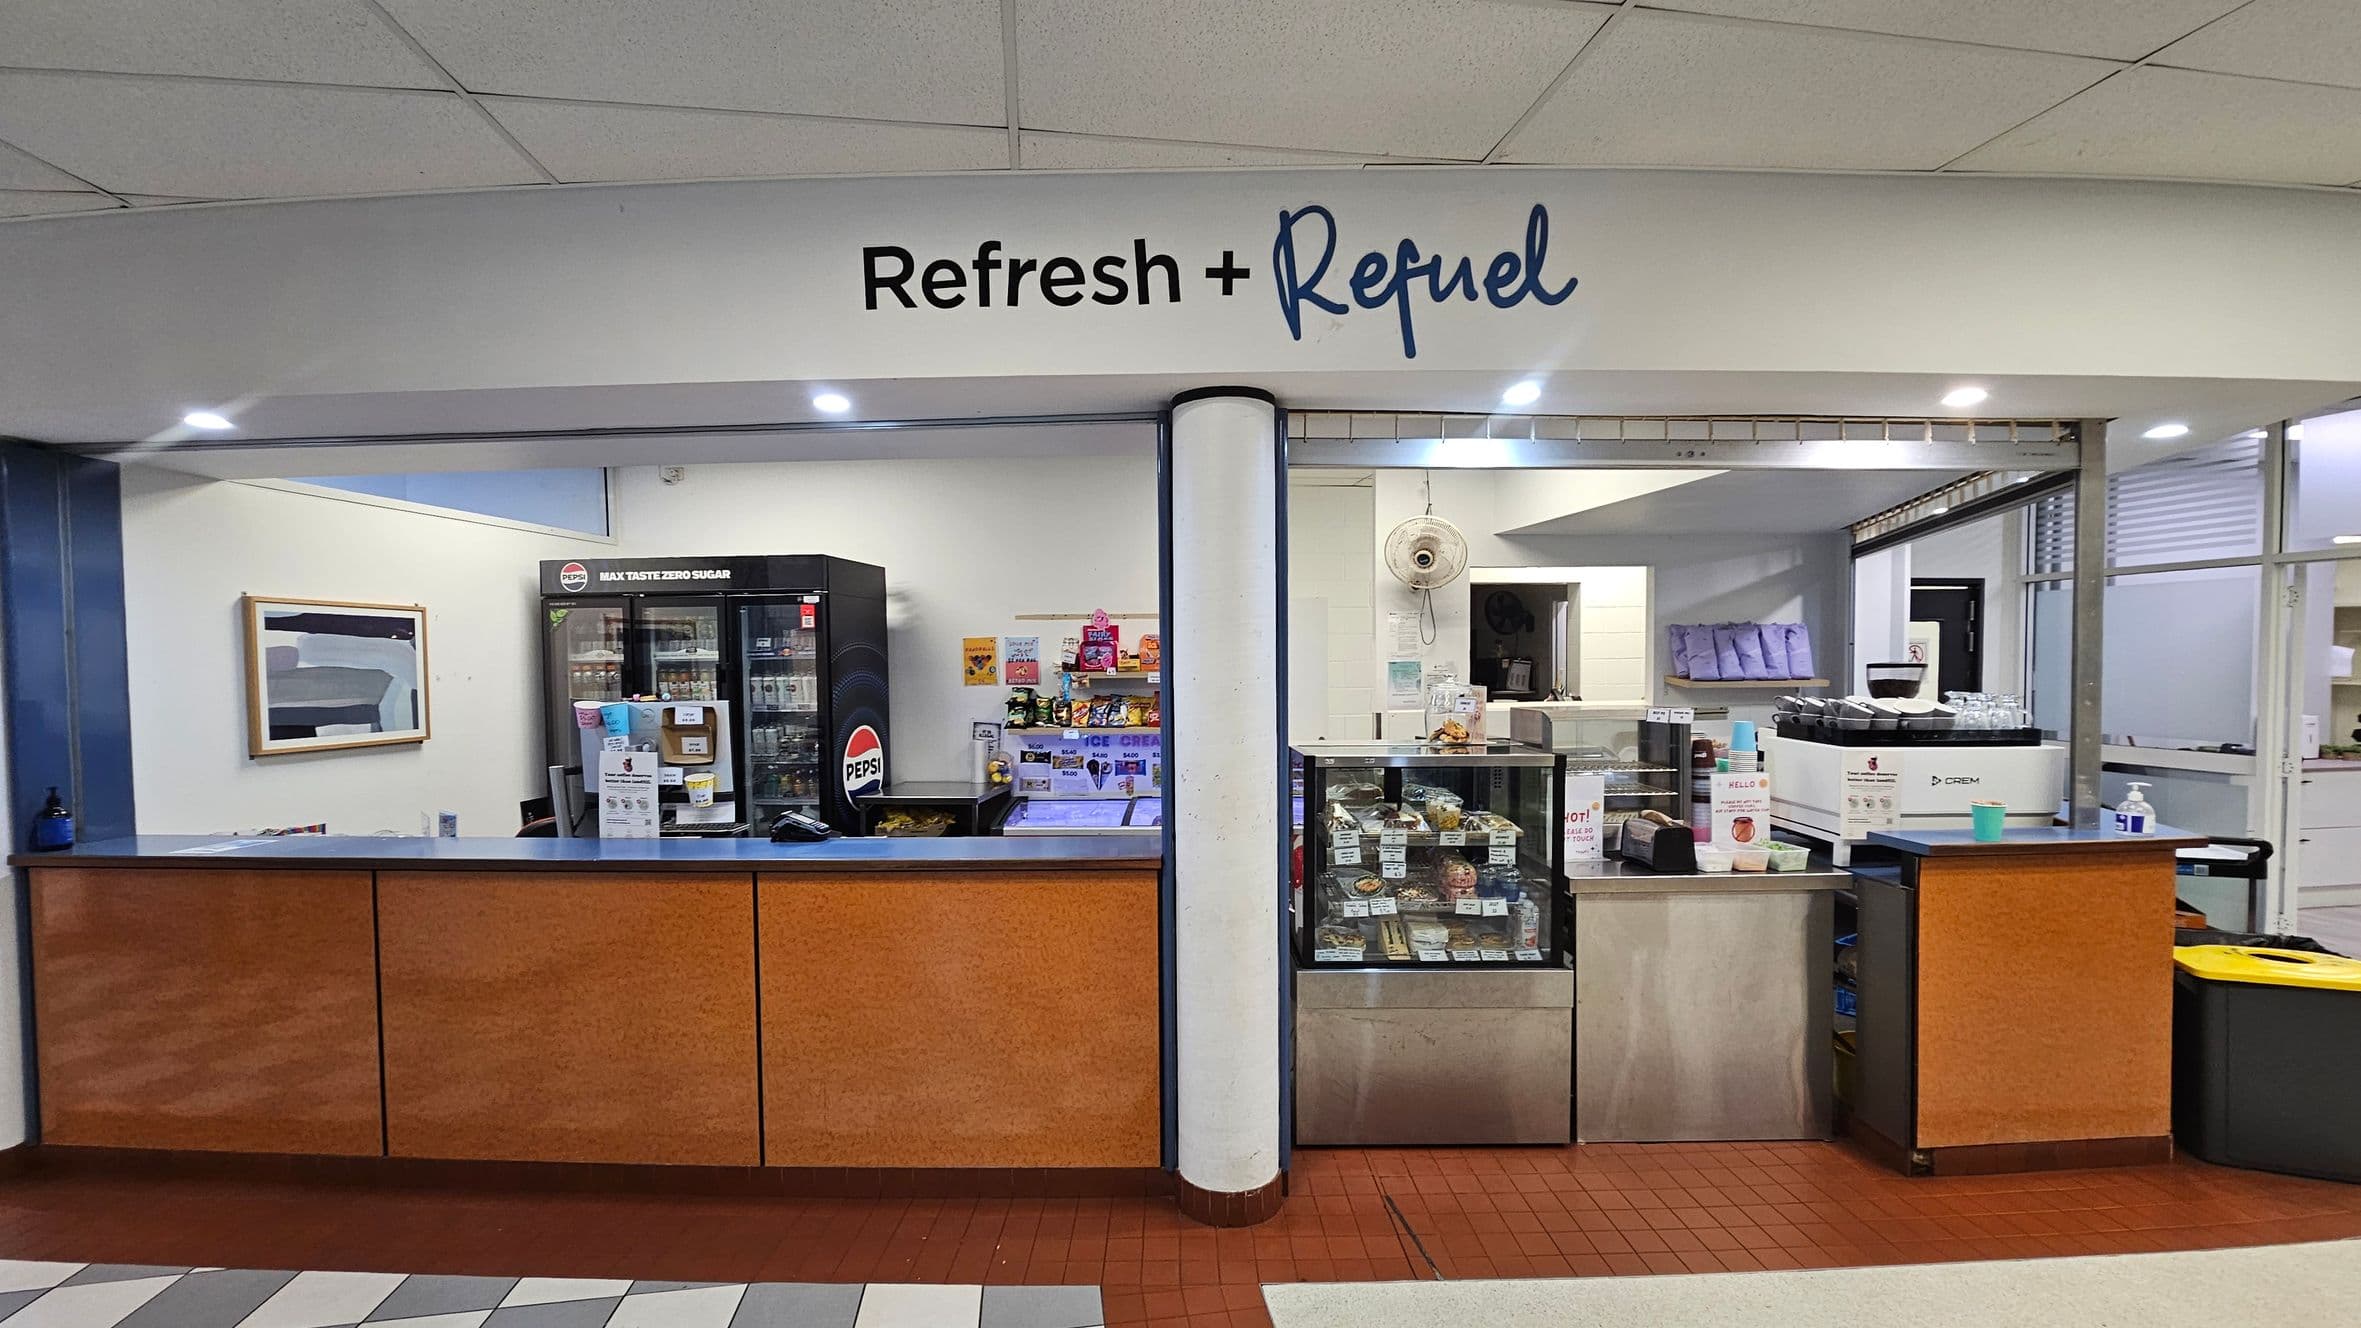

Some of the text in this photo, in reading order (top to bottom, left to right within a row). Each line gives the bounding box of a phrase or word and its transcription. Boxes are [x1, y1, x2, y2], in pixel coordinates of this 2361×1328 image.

[862, 203, 1579, 359] Refresh + Refuel
[600, 569, 731, 582] MAX TASTE ZERO SUGAR
[1085, 735, 1160, 747] ICE CREA
[1728, 780, 1756, 789] HELLO
[1945, 777, 1980, 785] CREM
[1572, 834, 1594, 842] TOUCH
